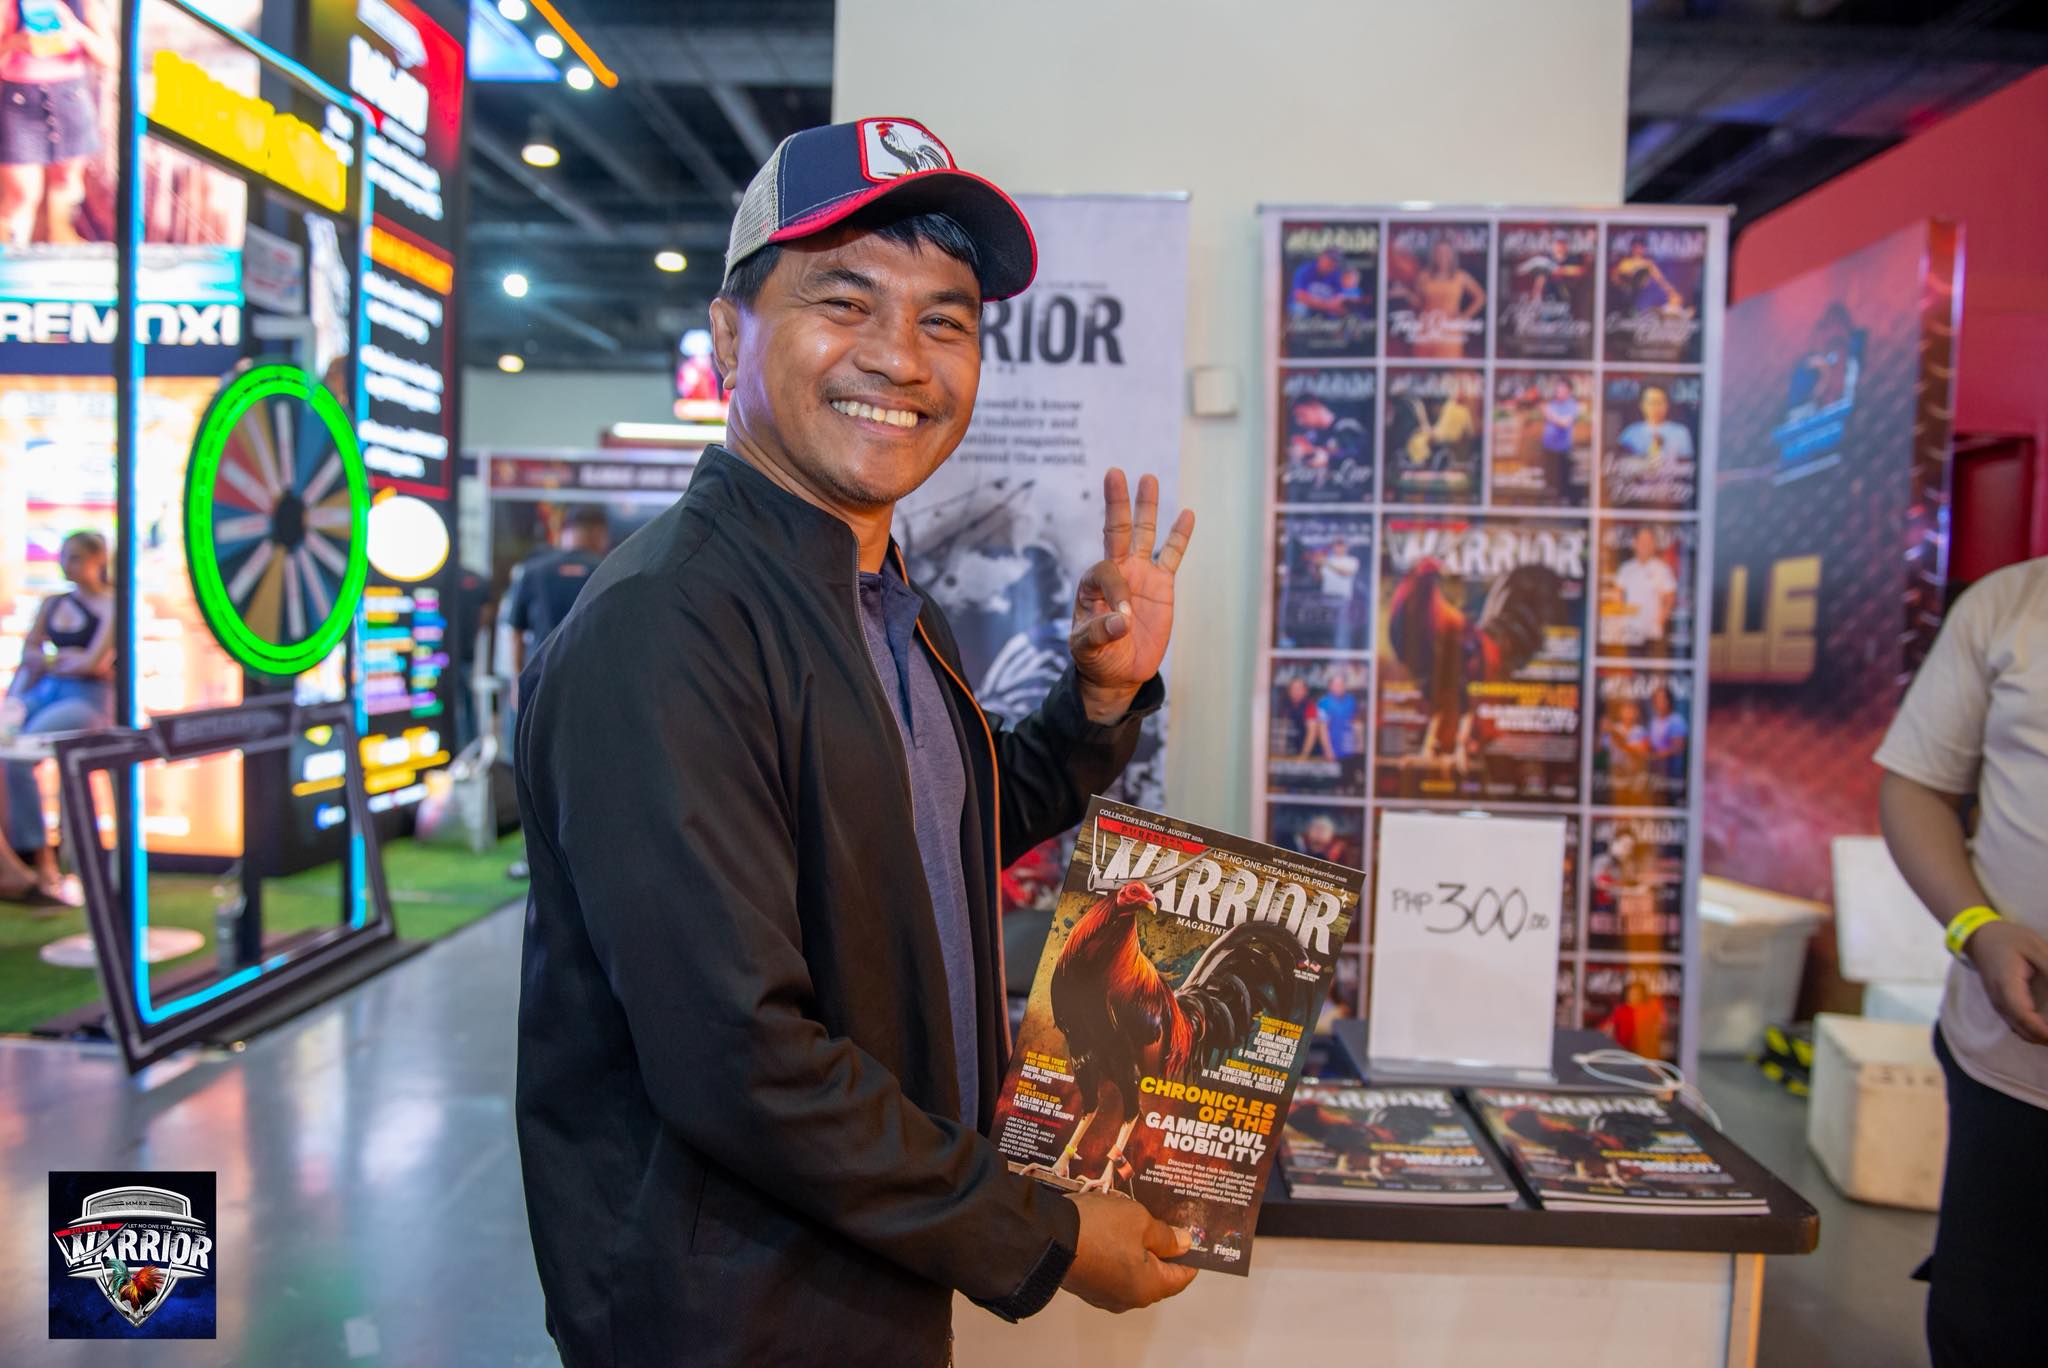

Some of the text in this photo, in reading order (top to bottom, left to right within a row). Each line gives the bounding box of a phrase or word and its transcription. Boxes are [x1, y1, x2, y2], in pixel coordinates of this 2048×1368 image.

[1710, 555, 1821, 683] LE
[1138, 820, 1165, 832] EDITION
[1167, 828, 1191, 839] AUGUST
[1212, 850, 1335, 891] LET NO ONE STEAL YOUR PRIDE
[1087, 818, 1342, 955] WARRIOR
[1253, 1037, 1297, 1054] BEGINNINGS TO
[1257, 1030, 1299, 1046] FROM HUMBLE
[1243, 1050, 1265, 1061] PUBLIC
[1264, 1055, 1291, 1068] SERVANT
[1279, 1051, 1294, 1061] ICON
[1020, 1070, 1052, 1084] PHILIPPINES
[1022, 1064, 1040, 1073] INSIDE
[1218, 1064, 1252, 1079] PIONEERING
[1258, 1074, 1273, 1084] NEW
[1272, 1077, 1286, 1087] ERA
[1201, 1068, 1284, 1094] IN THE GAMEFOWL INDUSTRY
[1012, 1098, 1040, 1111] TRADITION
[1039, 1106, 1051, 1114] AND
[1019, 1094, 1055, 1108] CELEBRATION
[1054, 1103, 1062, 1111] OF
[1138, 1075, 1278, 1120] CHRONICLES
[1005, 1121, 1022, 1129] DANTE
[1016, 1118, 1038, 1127] COLLINS
[1197, 1105, 1273, 1135] OF THE
[1143, 1110, 1269, 1151] GAMEFOWL
[1027, 1150, 1057, 1162] BENEDICTO
[1163, 1131, 1264, 1166] NOBILITY
[1145, 1168, 1173, 1179] breeding
[1192, 1177, 1215, 1188] special
[1153, 1162, 1192, 1176] unparalleled
[1191, 1170, 1217, 1181] mastery
[1225, 1177, 1255, 1189] gamefowl
[1167, 1158, 1194, 1169] Discover
[1205, 1166, 1219, 1174] rich
[1218, 1168, 1245, 1180] heritage
[1244, 1174, 1257, 1182] and
[1139, 1173, 1153, 1181] into
[1163, 1178, 1186, 1188] stories
[1192, 1184, 1224, 1196] legendary
[1223, 1191, 1251, 1201] breeders
[1200, 1193, 1231, 1204] champion
